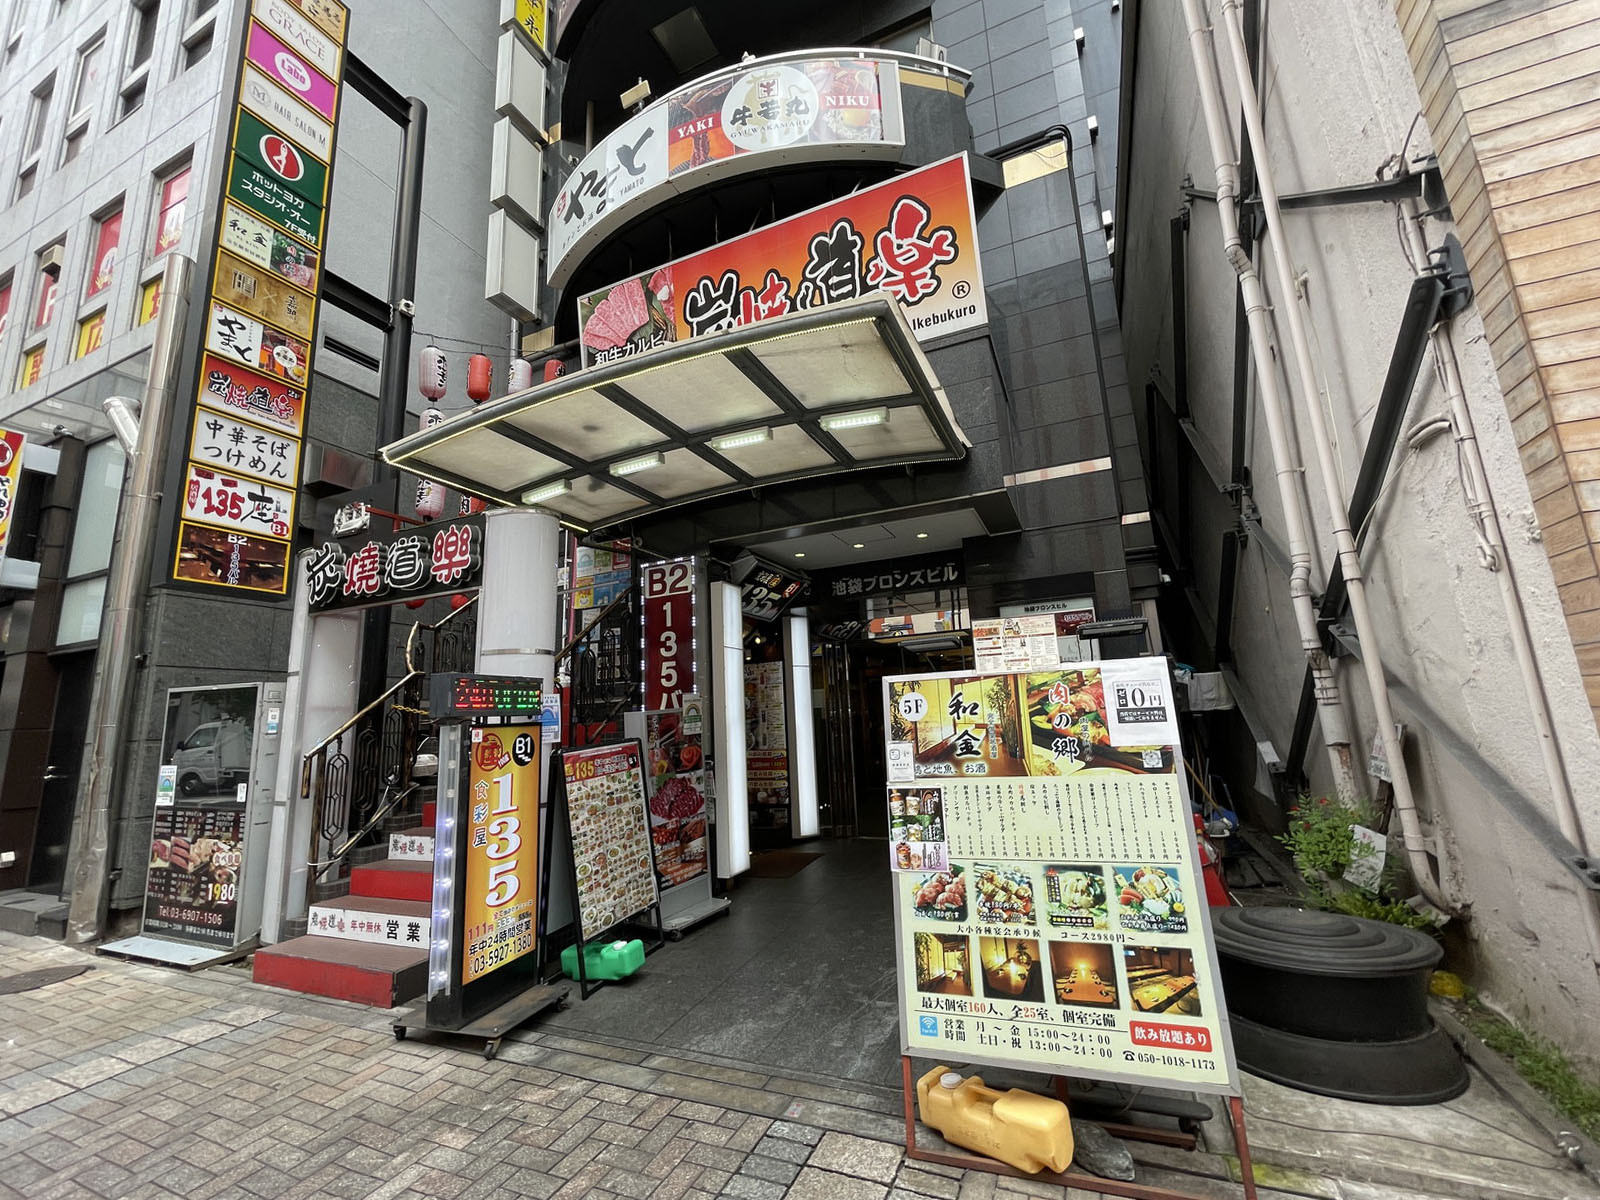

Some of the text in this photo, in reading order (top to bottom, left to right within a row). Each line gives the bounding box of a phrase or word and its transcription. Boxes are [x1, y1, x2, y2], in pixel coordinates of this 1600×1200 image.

[269, 8, 325, 61] GRACE
[730, 96, 810, 126] 牛若丸
[825, 95, 870, 107] NIKU
[274, 103, 326, 147] HAIR SALON M
[677, 116, 714, 138] YAKI
[730, 119, 810, 139] GYUWAKAMARU
[563, 127, 655, 225] やまと
[619, 176, 645, 197] YAMATO
[252, 170, 304, 210] ホットヨガ
[241, 179, 310, 226] スタジオ・オー
[284, 219, 317, 244] 7F受付
[912, 303, 977, 331] Ikebukuro
[595, 331, 665, 365] 和牛カルビ
[206, 419, 291, 460] 中華そば
[203, 446, 287, 479] つけめん
[228, 534, 248, 545] B2
[272, 523, 288, 535] B1
[649, 563, 689, 596] B2
[831, 564, 959, 597] 池袋ブロンズビル
[903, 699, 923, 715] 5F
[1117, 689, 1127, 705] ゼロ
[1131, 688, 1162, 708] 0円
[949, 692, 981, 757] 和金
[1048, 681, 1079, 763] 肉の郷
[516, 737, 531, 753] B1
[575, 761, 594, 780] 135
[473, 780, 489, 848] 食彩屋
[486, 773, 522, 908] 135
[207, 883, 235, 901] 1980
[350, 920, 382, 934] 年中無休
[386, 919, 421, 942] 営業
[468, 923, 494, 941] 111円
[469, 922, 532, 957] 年中24時間営業
[956, 925, 1042, 938] 大小各種宴会承り候
[474, 934, 532, 975] 03-5927-1380
[943, 1018, 966, 1031] 営業
[944, 1030, 967, 1042] 時間
[977, 1033, 1022, 1049] 土日・祝
[1134, 1027, 1207, 1047] 飲み放題あり
[1138, 1053, 1215, 1070] 050-1018-1173
